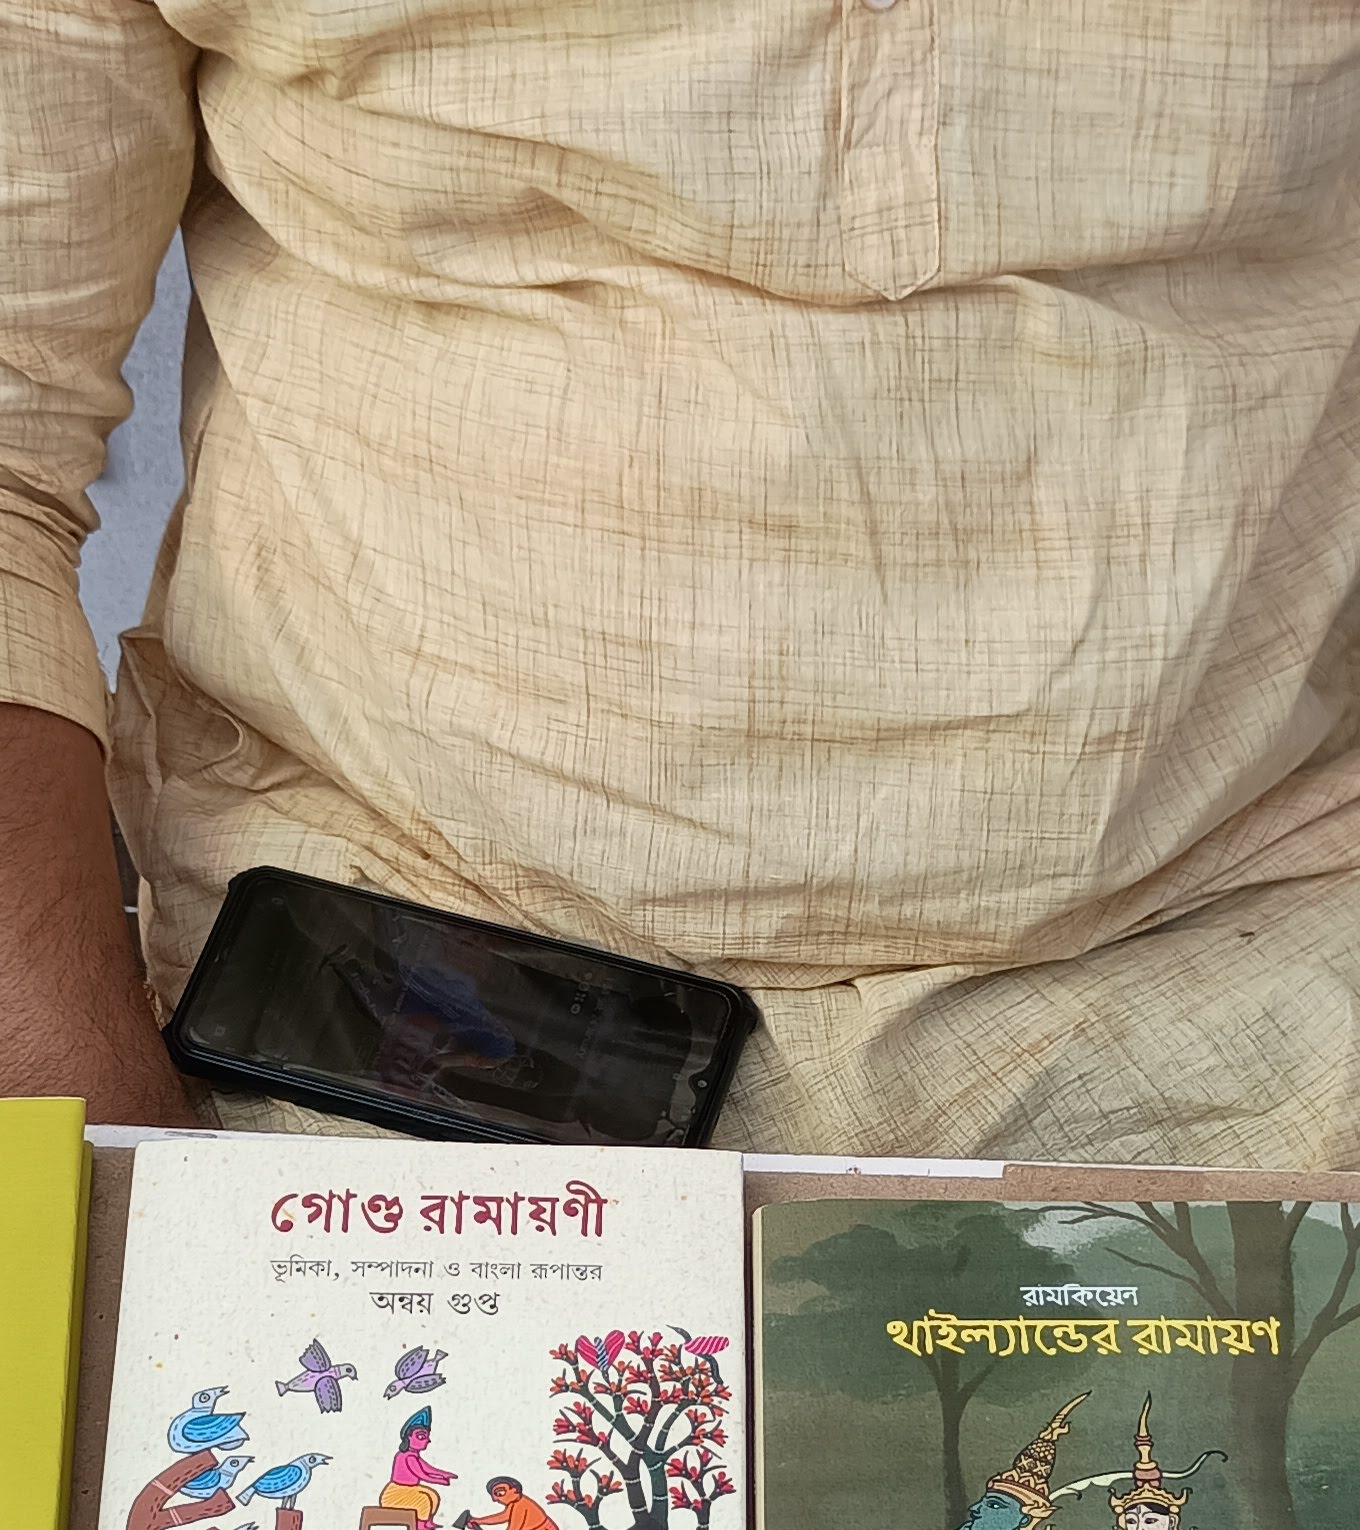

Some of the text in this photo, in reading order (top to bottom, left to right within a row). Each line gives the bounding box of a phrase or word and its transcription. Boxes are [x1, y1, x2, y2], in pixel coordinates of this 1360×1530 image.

[420, 1180, 609, 1237] রামায়ণী
[270, 1254, 603, 1283] ভূমিকা, সম্পাদনা ও বাংলা রূপান্তর
[369, 1291, 500, 1315] অন্বয় গুপ্ত
[1019, 1284, 1138, 1307] রামকিয়েন
[886, 1309, 1281, 1357] থাইল্যান্ডের রামায়ণ
